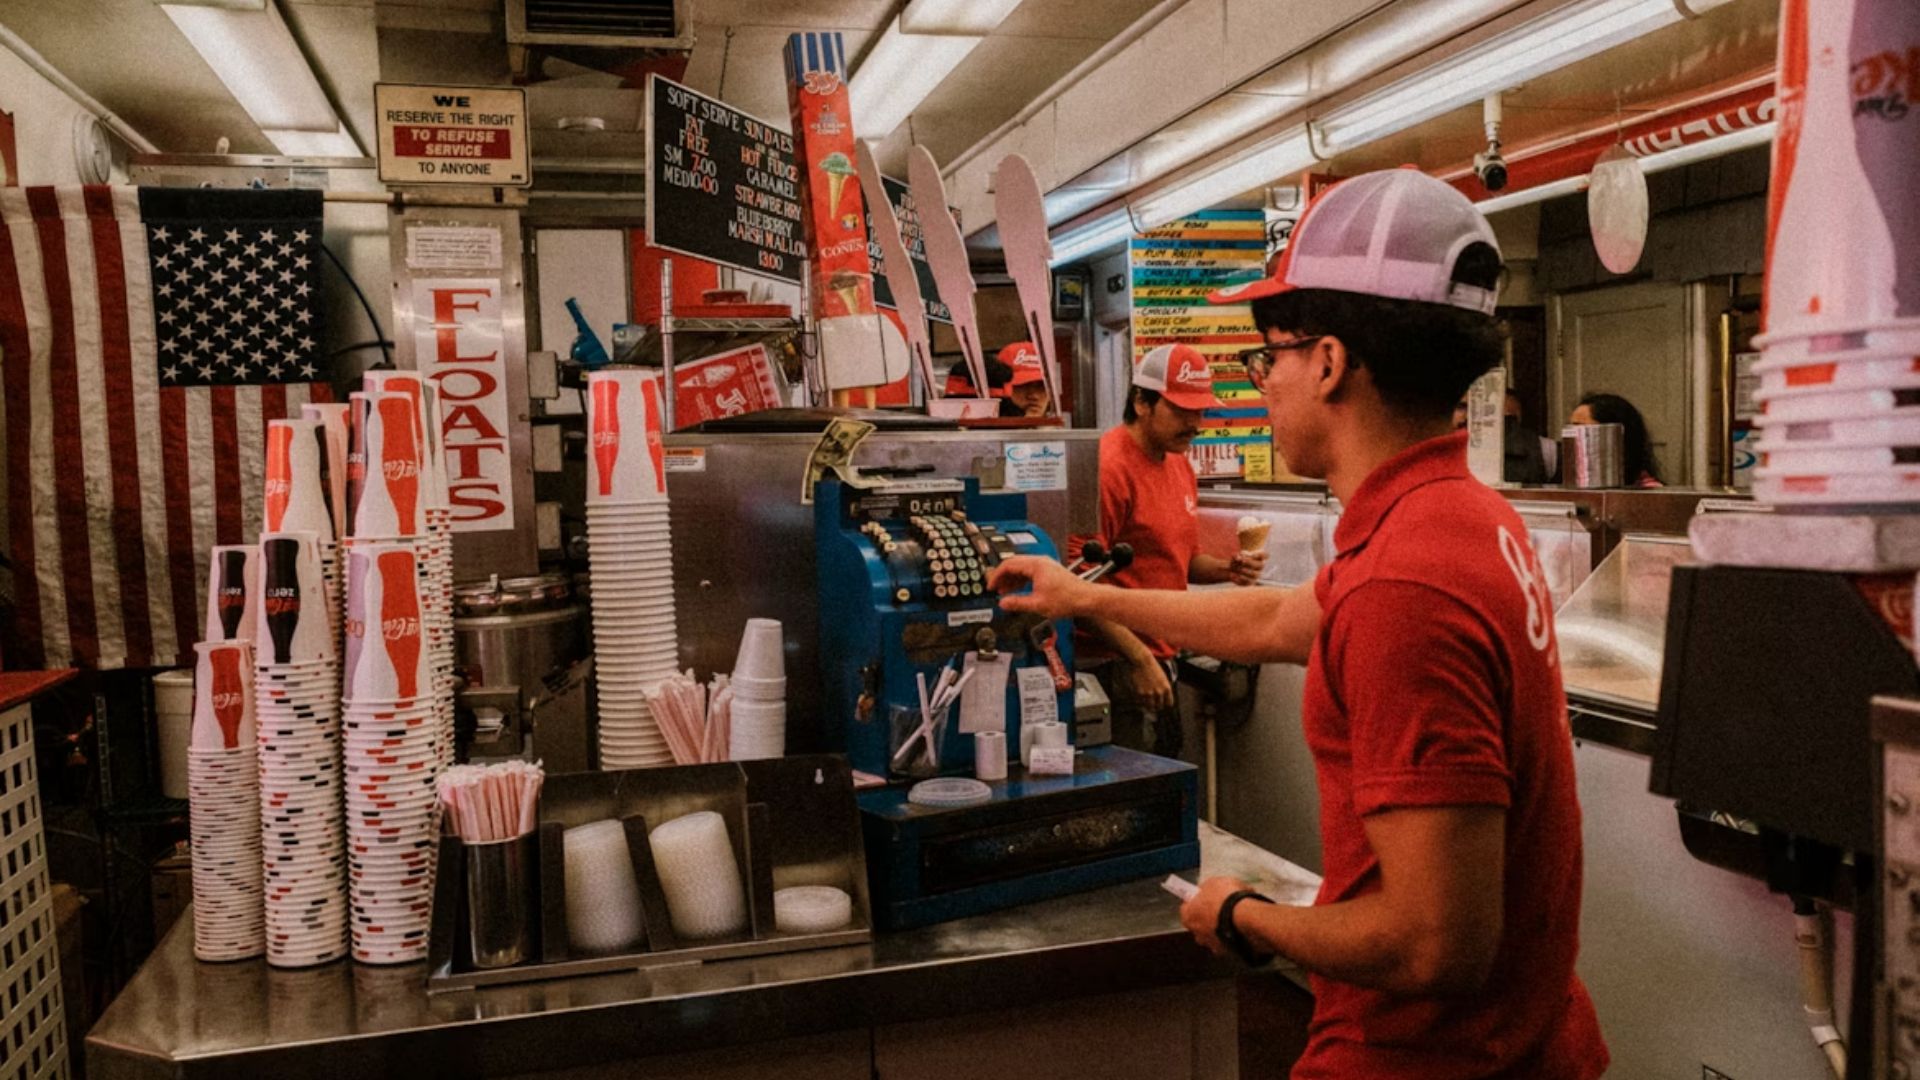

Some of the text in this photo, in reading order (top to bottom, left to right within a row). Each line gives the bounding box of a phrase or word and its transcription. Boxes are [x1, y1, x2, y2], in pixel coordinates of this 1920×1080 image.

[433, 96, 470, 107] WE
[387, 110, 515, 126] RESERVE THE RIGHT
[667, 86, 793, 154] SOFT SERVE SUNDAES
[685, 113, 705, 138] FAT
[411, 129, 496, 143] TO REFUSE
[679, 128, 710, 156] FREE
[425, 144, 483, 156] SERVICE
[664, 146, 683, 166] SM
[418, 161, 491, 175] TO ANYONE
[741, 145, 761, 168] HOT
[768, 156, 799, 183] FUDGE
[746, 167, 797, 200] CARAMEL
[735, 184, 801, 221] STRAWBERRY
[736, 206, 793, 238] BLUEBERRY
[821, 239, 864, 259] CONES
[1144, 249, 1167, 258] RUM
[1147, 288, 1182, 297] BUTTER
[1141, 308, 1188, 317] CHOCOLATE
[428, 288, 506, 522] FLOATS
